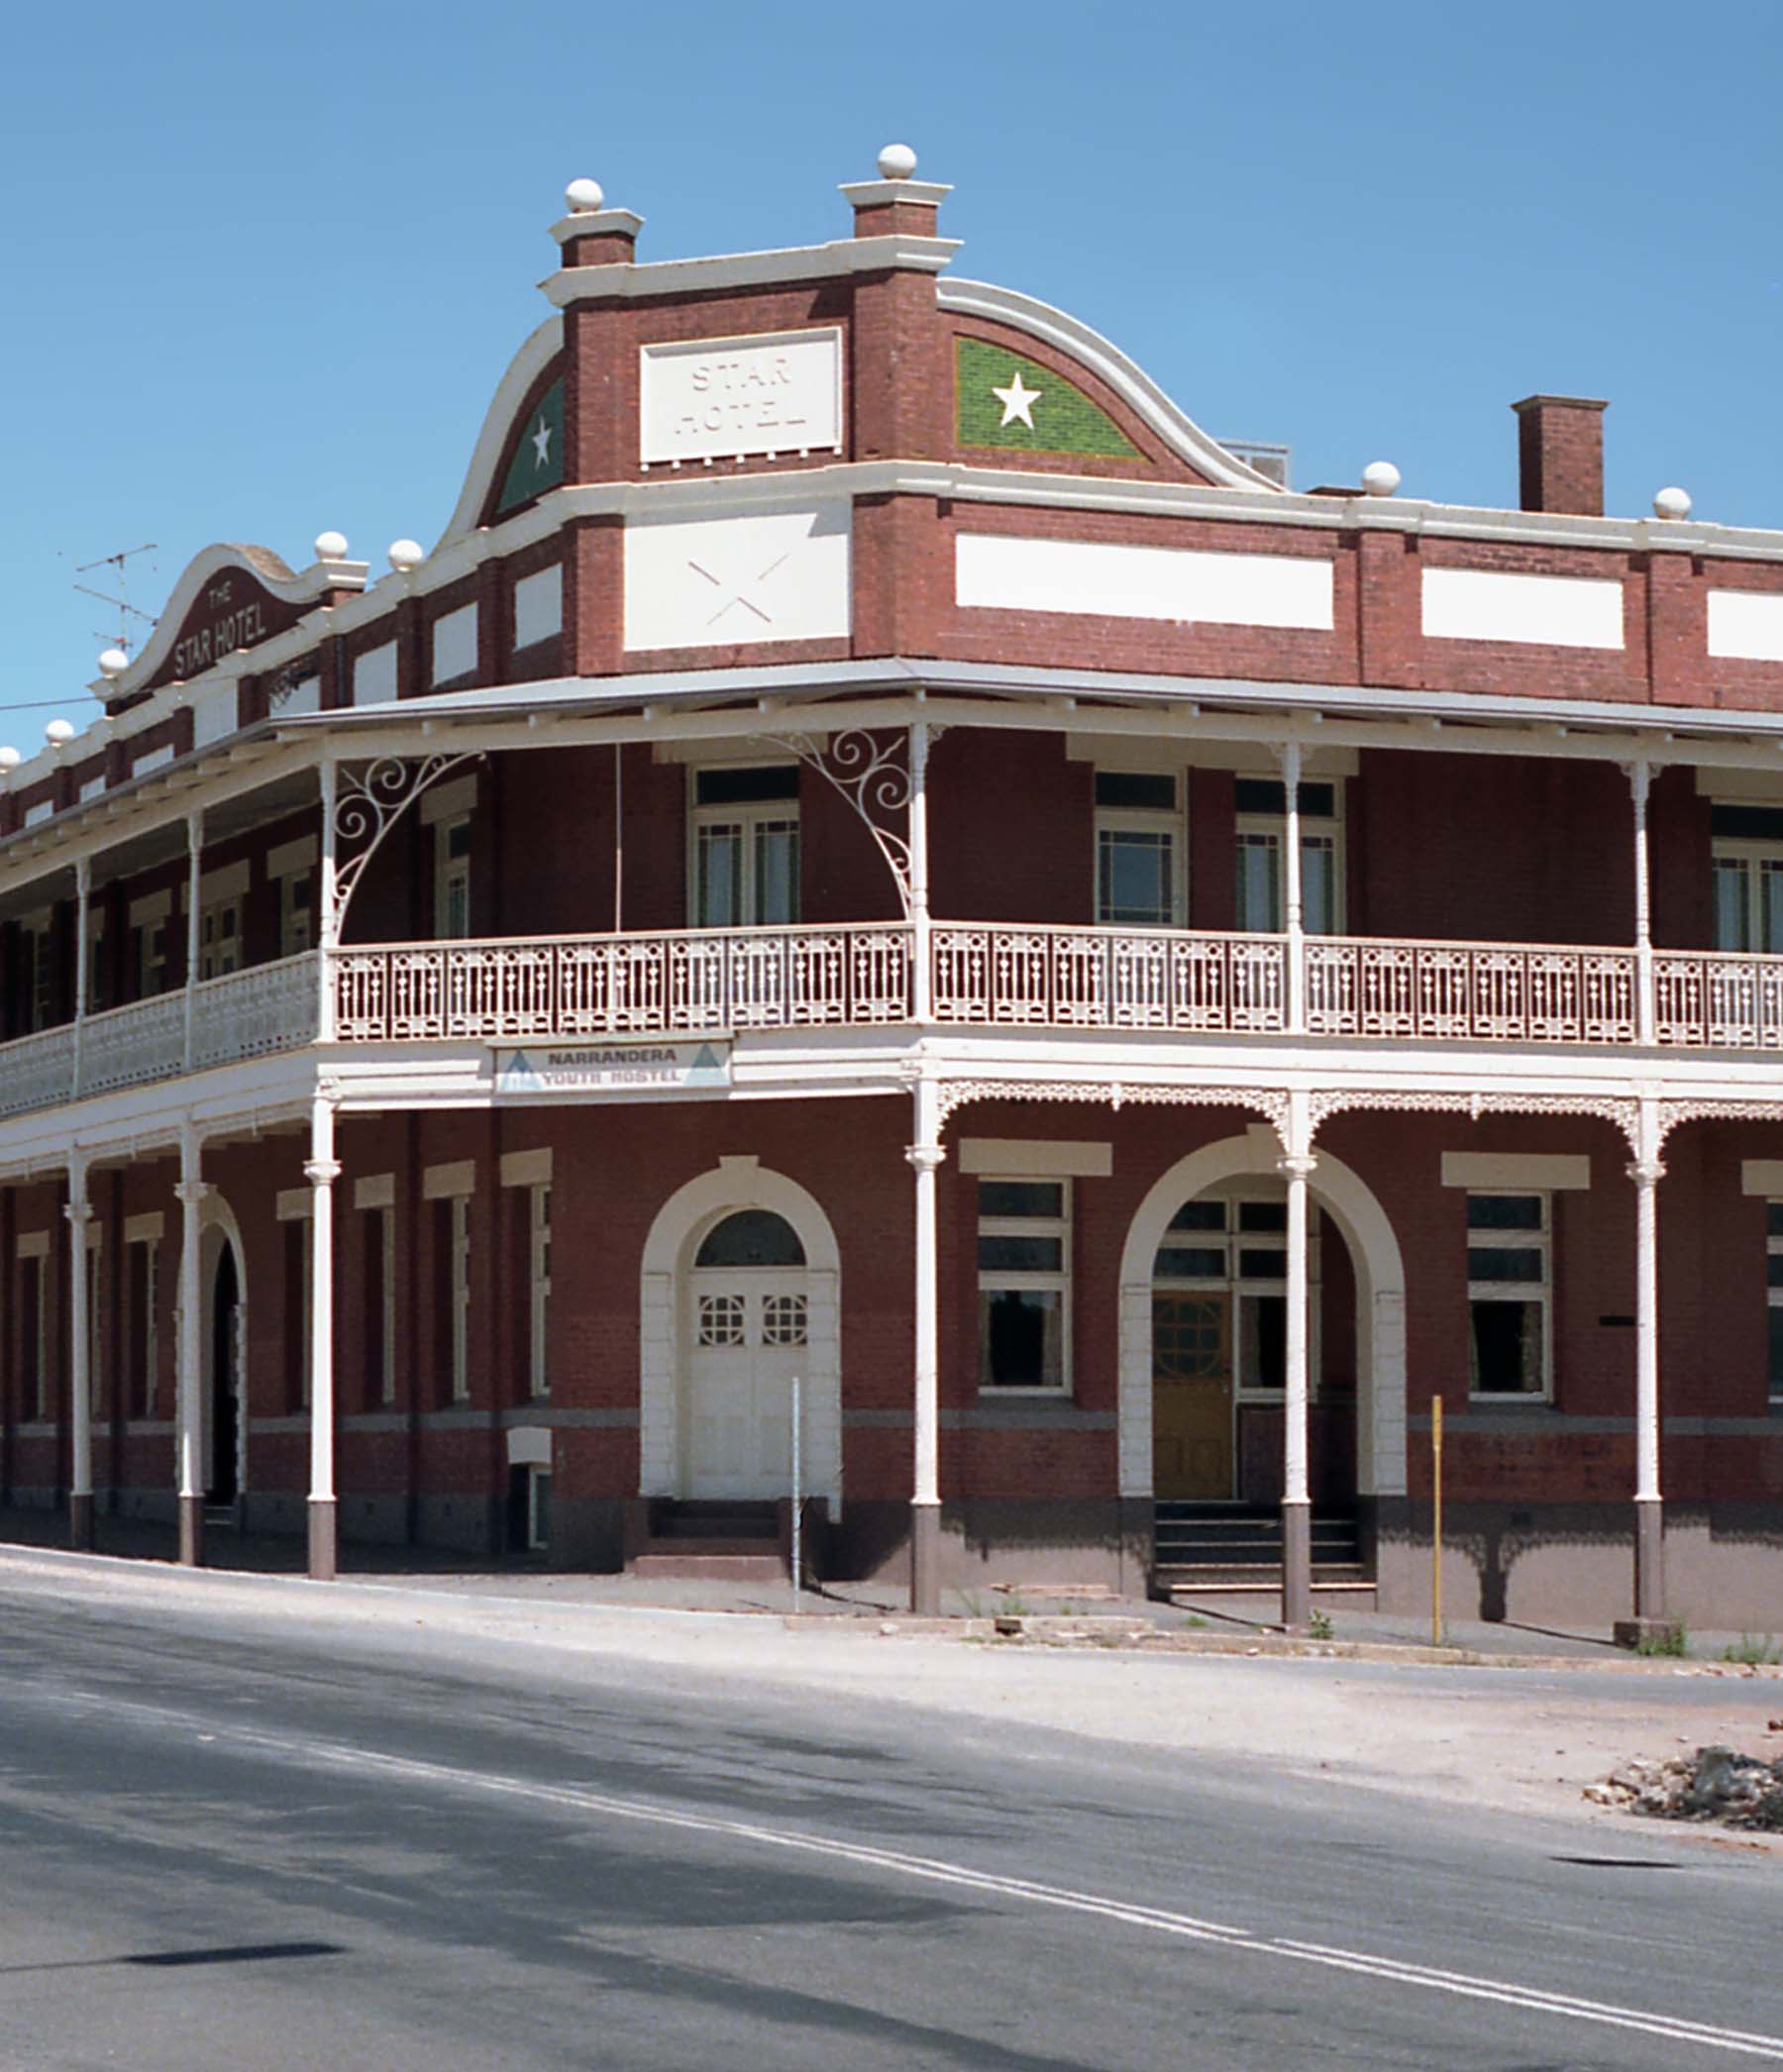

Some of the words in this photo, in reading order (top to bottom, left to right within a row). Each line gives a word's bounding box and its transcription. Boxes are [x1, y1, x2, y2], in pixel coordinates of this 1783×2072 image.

[692, 358, 790, 392] STAR
[674, 398, 807, 434] HOTEL
[207, 579, 233, 609] THE
[174, 628, 213, 676] STAR
[214, 601, 266, 657] HOTEL
[549, 1048, 677, 1065] NARRANDERA
[542, 1071, 601, 1086] YOUTH
[610, 1068, 682, 1084] HOSTEL
